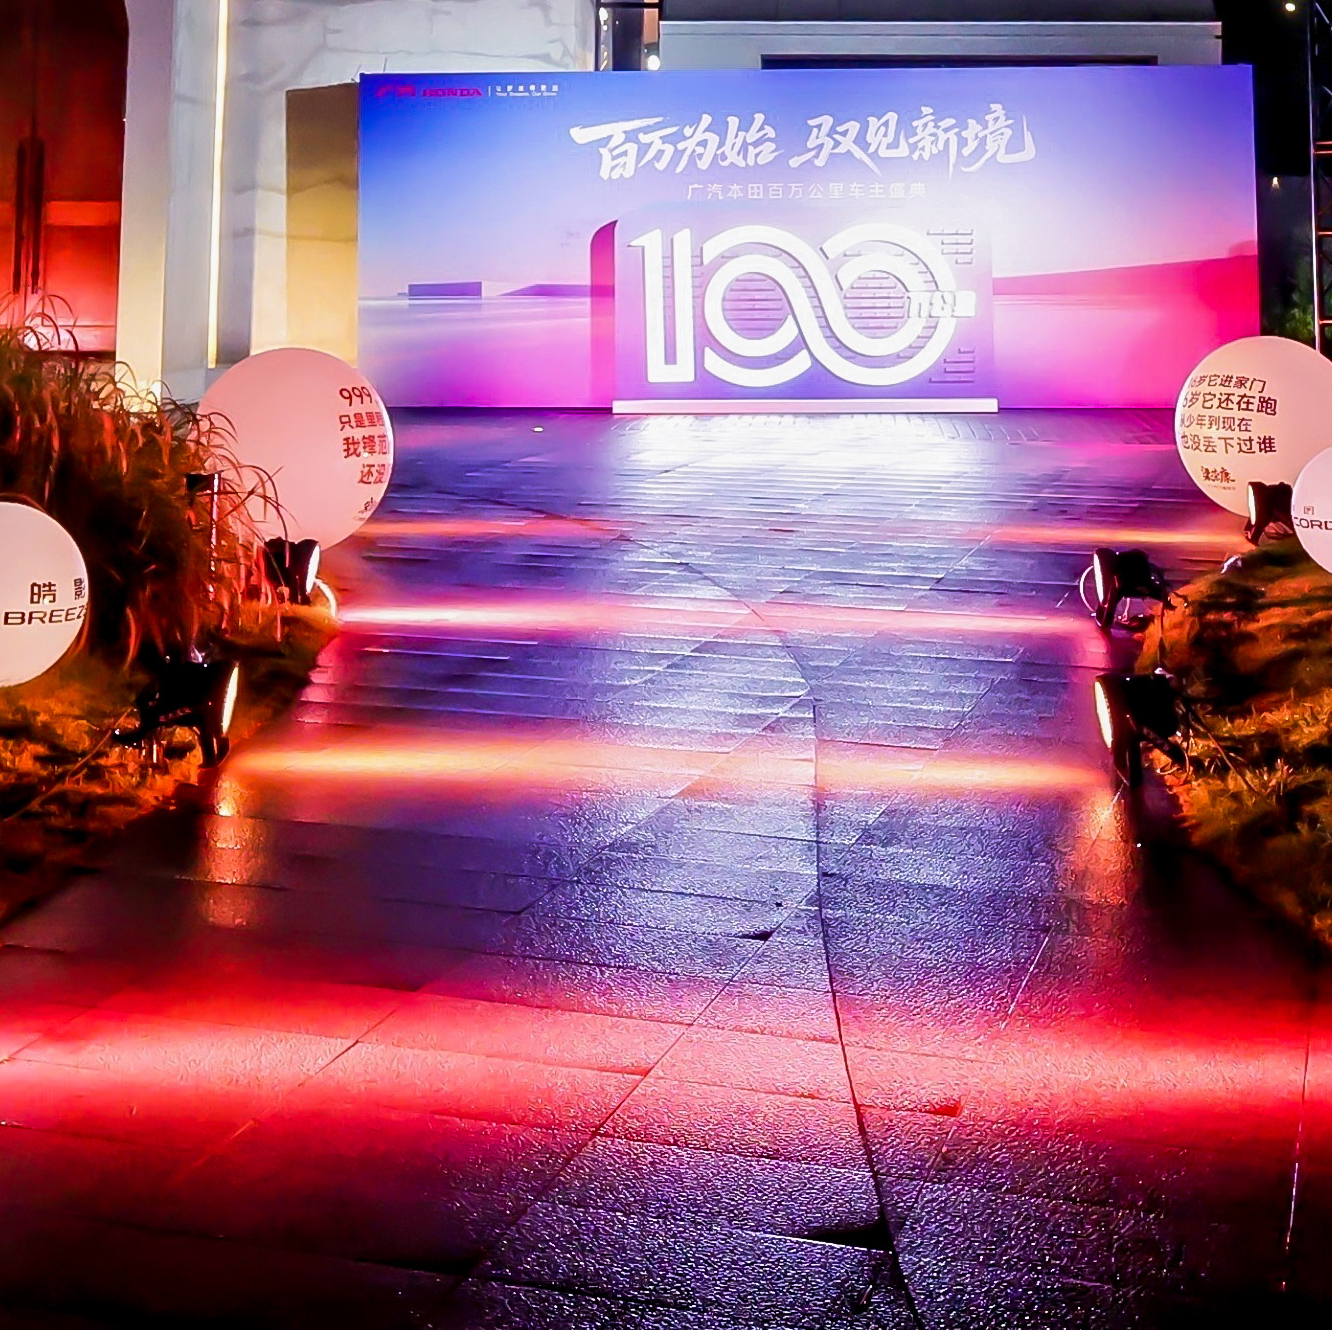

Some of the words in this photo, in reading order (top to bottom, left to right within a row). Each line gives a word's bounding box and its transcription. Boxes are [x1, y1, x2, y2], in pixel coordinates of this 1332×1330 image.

[686, 182, 928, 201] 广汽本田百万公里车主盛典
